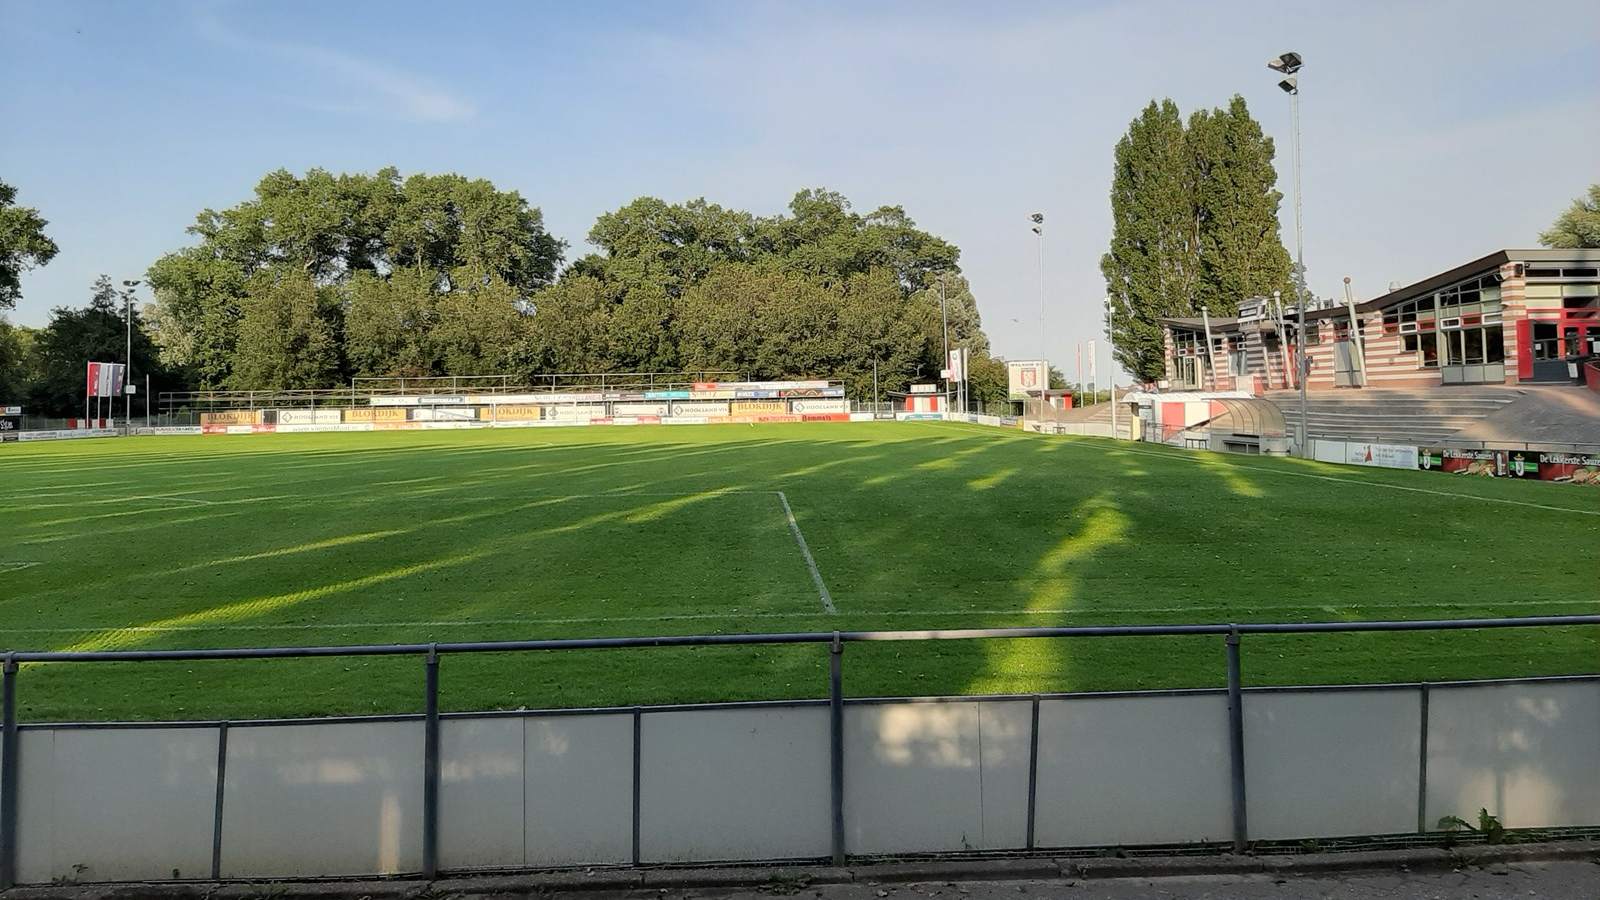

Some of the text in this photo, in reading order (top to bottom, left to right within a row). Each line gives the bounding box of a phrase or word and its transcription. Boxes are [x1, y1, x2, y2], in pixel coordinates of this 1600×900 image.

[486, 407, 533, 416] BOKDIJK
[738, 403, 782, 411] BLOKDIJK
[1540, 454, 1549, 463] De
[1550, 454, 1580, 465] Lekkerste
